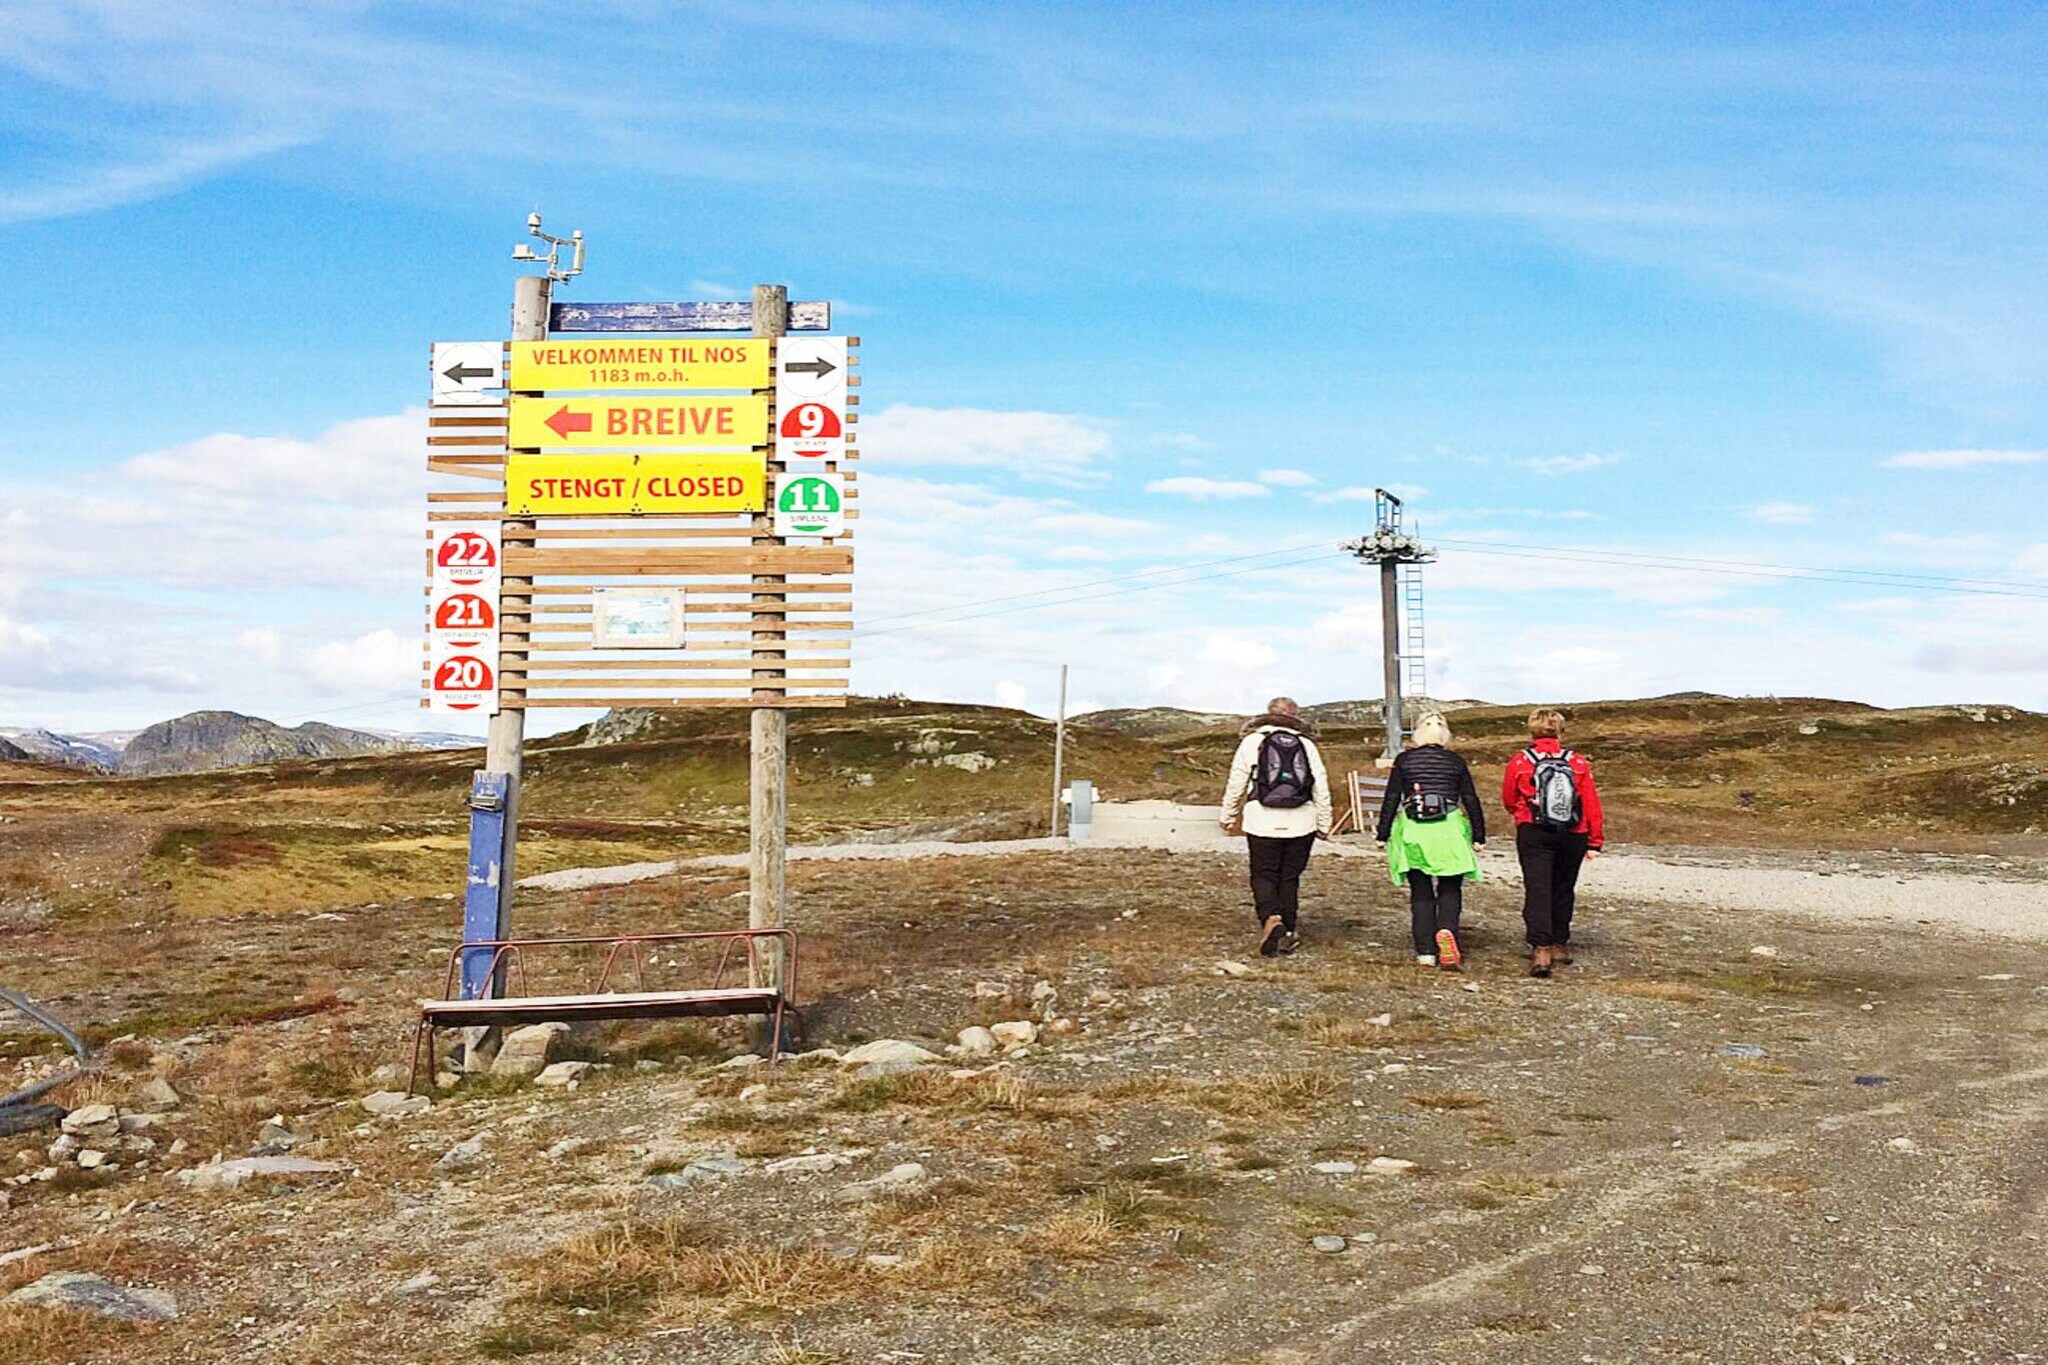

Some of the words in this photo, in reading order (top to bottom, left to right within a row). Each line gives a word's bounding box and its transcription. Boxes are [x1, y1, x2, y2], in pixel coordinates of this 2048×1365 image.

[532, 347, 663, 366] VELKOMMEN
[669, 347, 699, 364] TIL
[704, 346, 747, 364] NOS
[590, 369, 630, 382] 1183
[634, 368, 690, 382] m.o.h.
[607, 407, 734, 436] BREIVE
[799, 404, 825, 438] 9
[529, 477, 627, 499] STENGT
[631, 477, 641, 499] /
[646, 475, 745, 498] CLOSED
[789, 483, 831, 511] 11
[447, 538, 489, 566] 22
[446, 599, 485, 626] 21
[443, 661, 483, 688] 20
